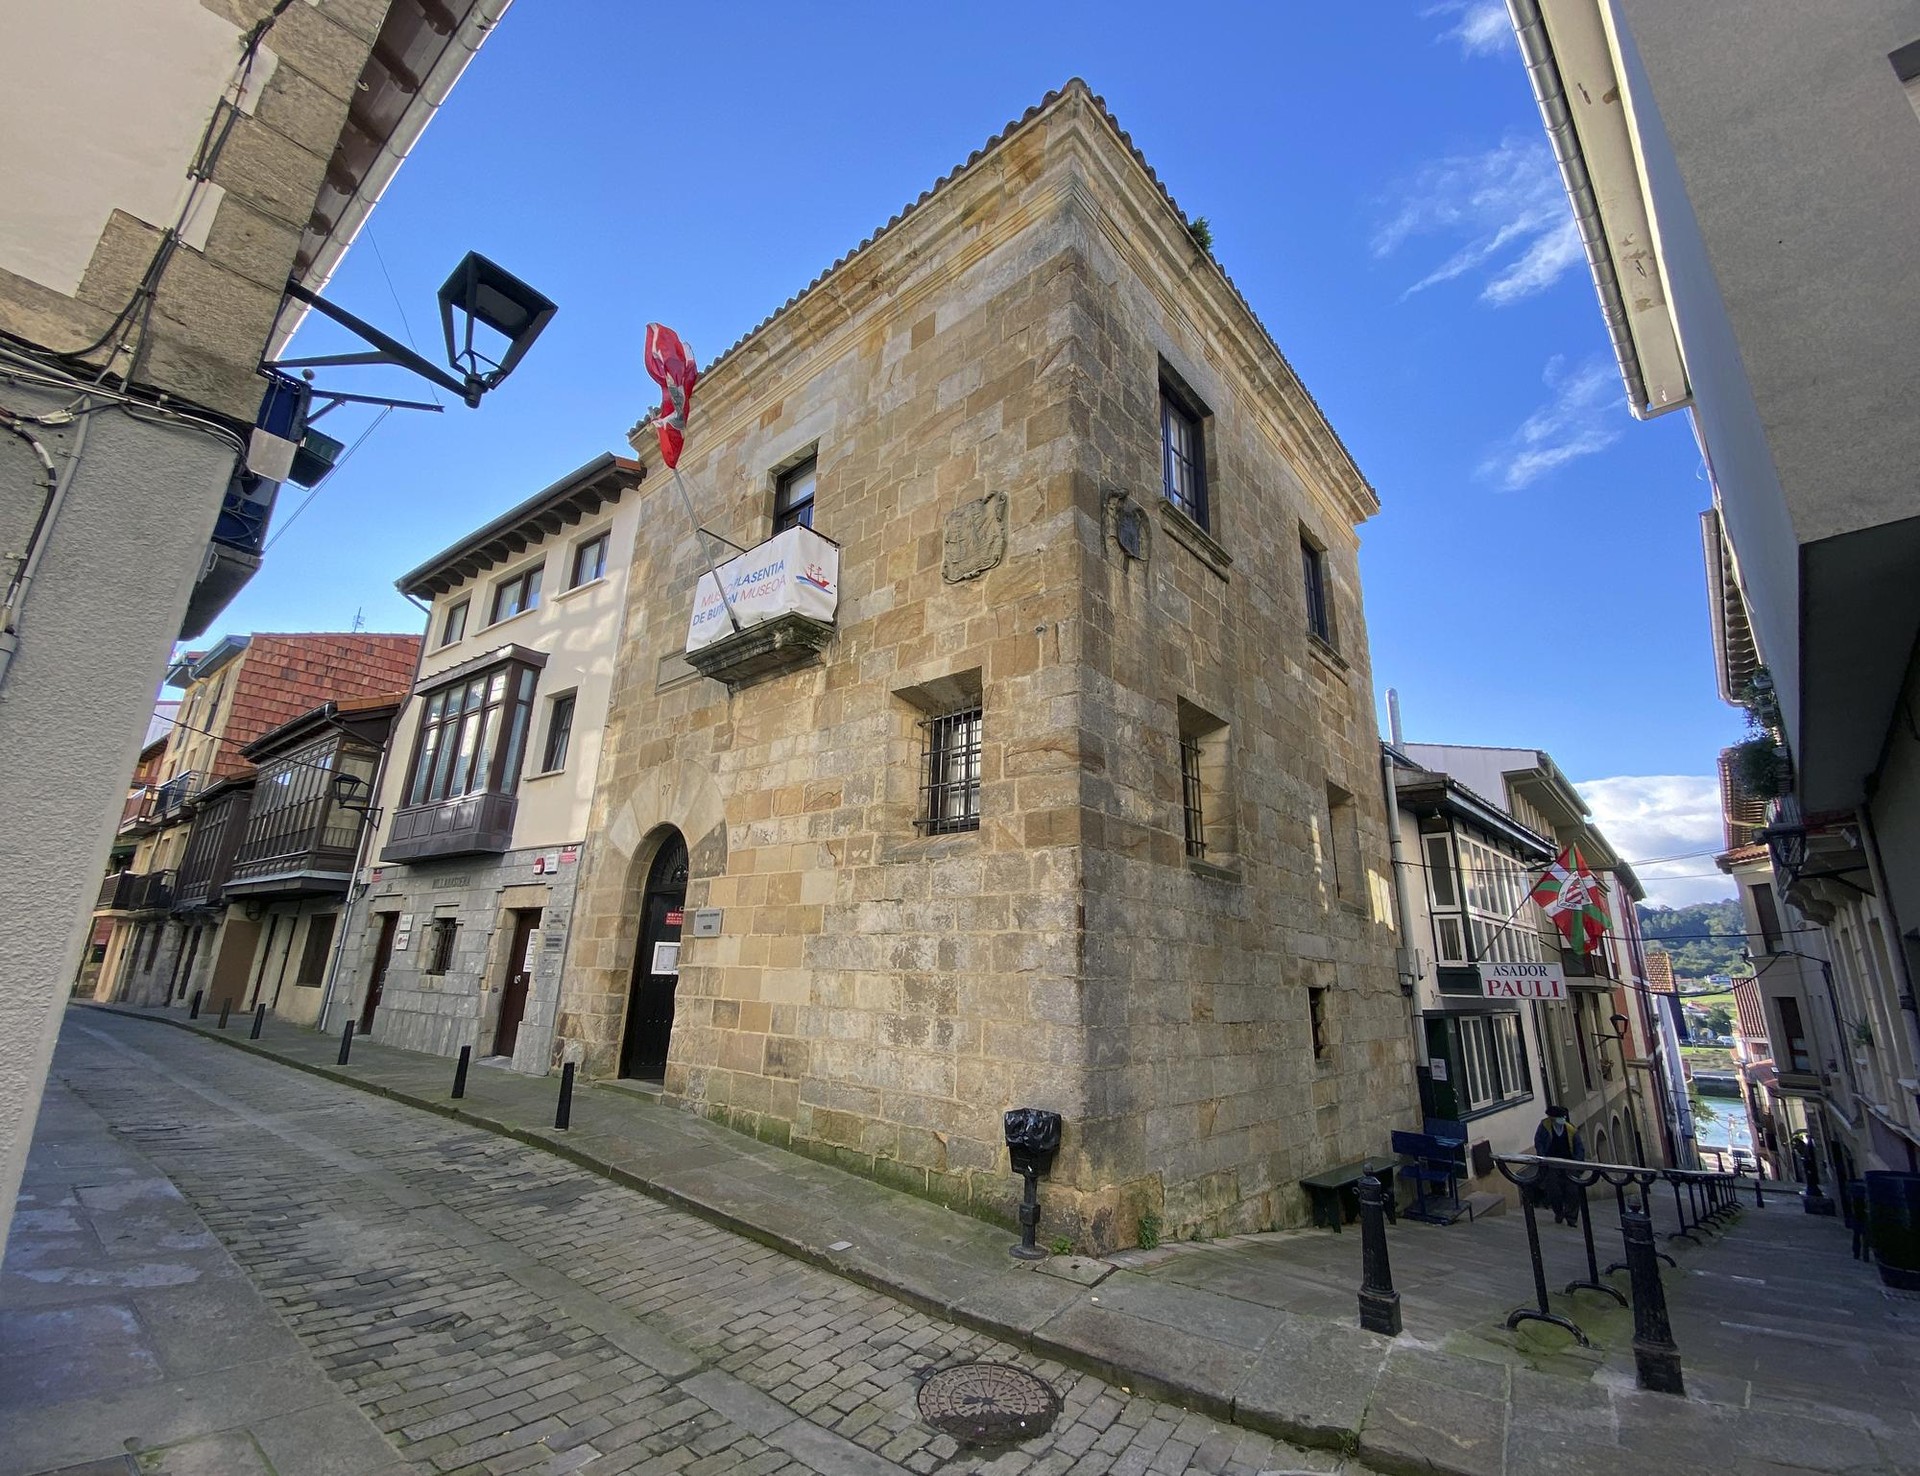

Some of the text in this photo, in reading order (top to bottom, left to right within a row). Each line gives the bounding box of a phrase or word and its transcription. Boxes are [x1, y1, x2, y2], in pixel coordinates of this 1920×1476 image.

[692, 611, 706, 627] DE
[740, 574, 786, 601] MUSEOA
[701, 583, 733, 607] MUSO
[1493, 965, 1549, 977] ASADOR
[1485, 979, 1560, 998] PAULI
